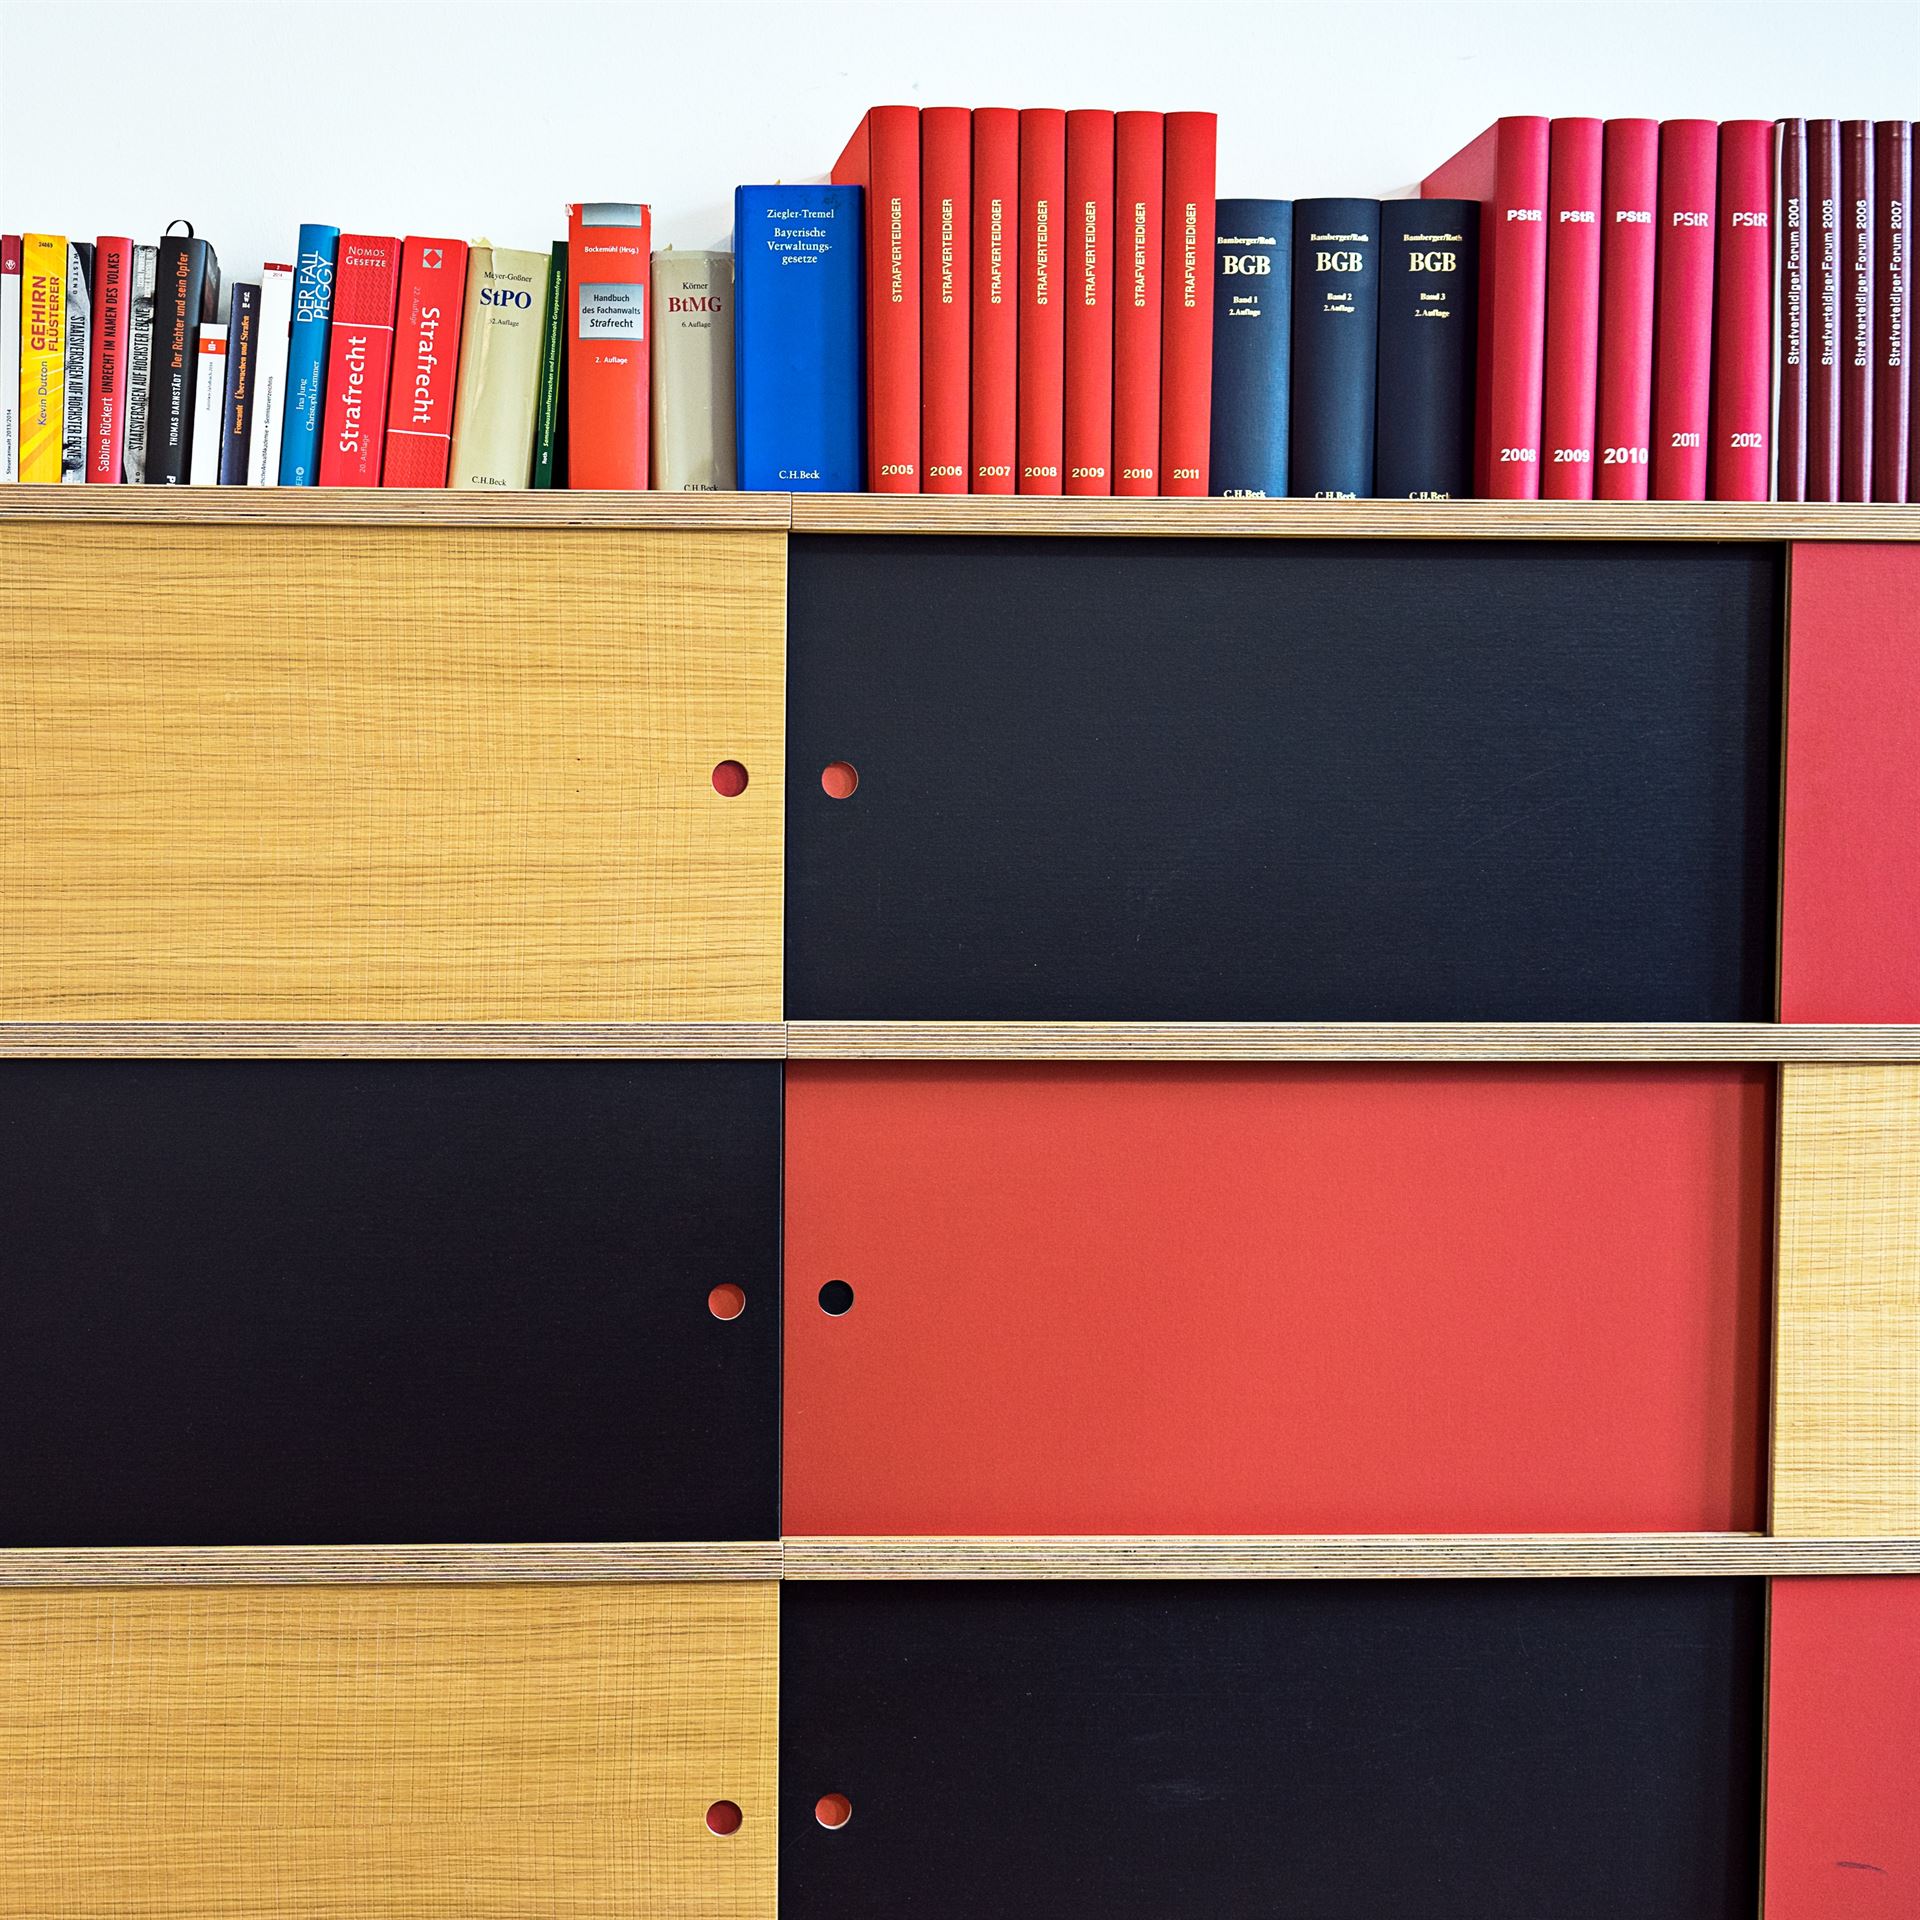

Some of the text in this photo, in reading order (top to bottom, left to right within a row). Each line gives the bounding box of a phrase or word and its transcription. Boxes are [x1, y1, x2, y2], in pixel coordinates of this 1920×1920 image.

[766, 209, 834, 220] Ziegler-Tremel
[1507, 209, 1542, 222] PStR
[1560, 210, 1595, 223] PStR
[1616, 210, 1652, 224] PStR
[1673, 212, 1708, 227] PStR
[1732, 212, 1768, 227] PStR
[774, 227, 826, 239] Bayerische
[1310, 234, 1369, 242] Bamberger/Roth
[618, 246, 639, 254] (Hrsg.)
[766, 240, 832, 253] Verwaltungs-
[891, 197, 902, 302] STRAFVERTEIDIGER
[942, 198, 952, 304] STRAFVERTEIDIGER
[991, 199, 1002, 304] STRAFVERTEIDIGER
[1037, 200, 1048, 305] STRAFVERTEIDIGER
[1085, 201, 1096, 306] STRAFVERTEIDIGER
[1135, 202, 1146, 307] STRAFVERTEIDIGER
[782, 255, 818, 266] gesetze
[1185, 203, 1196, 308] STRAFVERTEIDIGER
[1316, 252, 1364, 272] BGB
[1408, 252, 1456, 272] BGB
[1222, 255, 1271, 276] BGB
[484, 271, 533, 283] Meyer-Goßner
[1788, 198, 1801, 364] Strafverteidiger Forum 2004
[1822, 199, 1834, 366] Strafverteidiger Forum 2005
[1855, 200, 1868, 366] Strafverteidiger Forum 2006
[1889, 200, 1903, 366] Strafverteidiger Forum 2007
[296, 250, 319, 322] DER FALL
[314, 256, 334, 320] PEGGY
[682, 282, 709, 290] Körner
[480, 287, 532, 310] StPO
[593, 294, 630, 302] Handbuch
[668, 296, 722, 313] BtMG
[1233, 296, 1252, 304] Band
[1327, 292, 1352, 301] Band 2
[1420, 292, 1446, 301] Band 3
[31, 276, 47, 350] GEHIRN
[47, 276, 60, 352] FLÜSTERER
[582, 306, 641, 315] des Fachanwalts
[134, 308, 150, 336] EBENE
[240, 316, 250, 341] Strafen
[590, 318, 634, 328] Strafrecht
[69, 316, 86, 380] STAATSVERSAGEN
[133, 337, 149, 372] HÖCHSTER
[170, 252, 190, 446] THOMAS DARNSTÄDT Der Richter und sein Opfer
[98, 253, 120, 472] Sabine Rückert UNRECHT IM NAMEN DES VOLKES
[412, 306, 440, 424] Strafrecht
[604, 356, 628, 365] Auflage
[68, 380, 84, 394] AUF
[132, 372, 148, 386] AUF
[38, 361, 48, 426] Kevin Dutton
[296, 378, 308, 410] Ina Jung
[306, 361, 320, 432] Christoph Lemmer
[340, 336, 367, 453] Strafrecht
[68, 395, 84, 434] HÖCHSTER
[129, 387, 147, 450] STAATSVERSAGEN
[66, 435, 82, 459] EBENE
[360, 434, 369, 462] Auflage
[1672, 432, 1700, 448] 2011
[1730, 433, 1762, 448] 2012
[1500, 448, 1536, 462] 2008
[1554, 449, 1590, 463] 2009
[1603, 448, 1648, 464] 2010
[778, 470, 820, 480] C.H.Beck
[881, 464, 914, 475] 2005
[930, 466, 963, 476] 2006
[978, 466, 1011, 477] 2007
[1024, 466, 1058, 478] 2008
[1072, 467, 1105, 478] 2009
[1123, 468, 1153, 479] 2010
[1173, 468, 1200, 480] 2011
[472, 476, 506, 486] C.H.Beck
[1223, 490, 1266, 498] C.H.Beck
